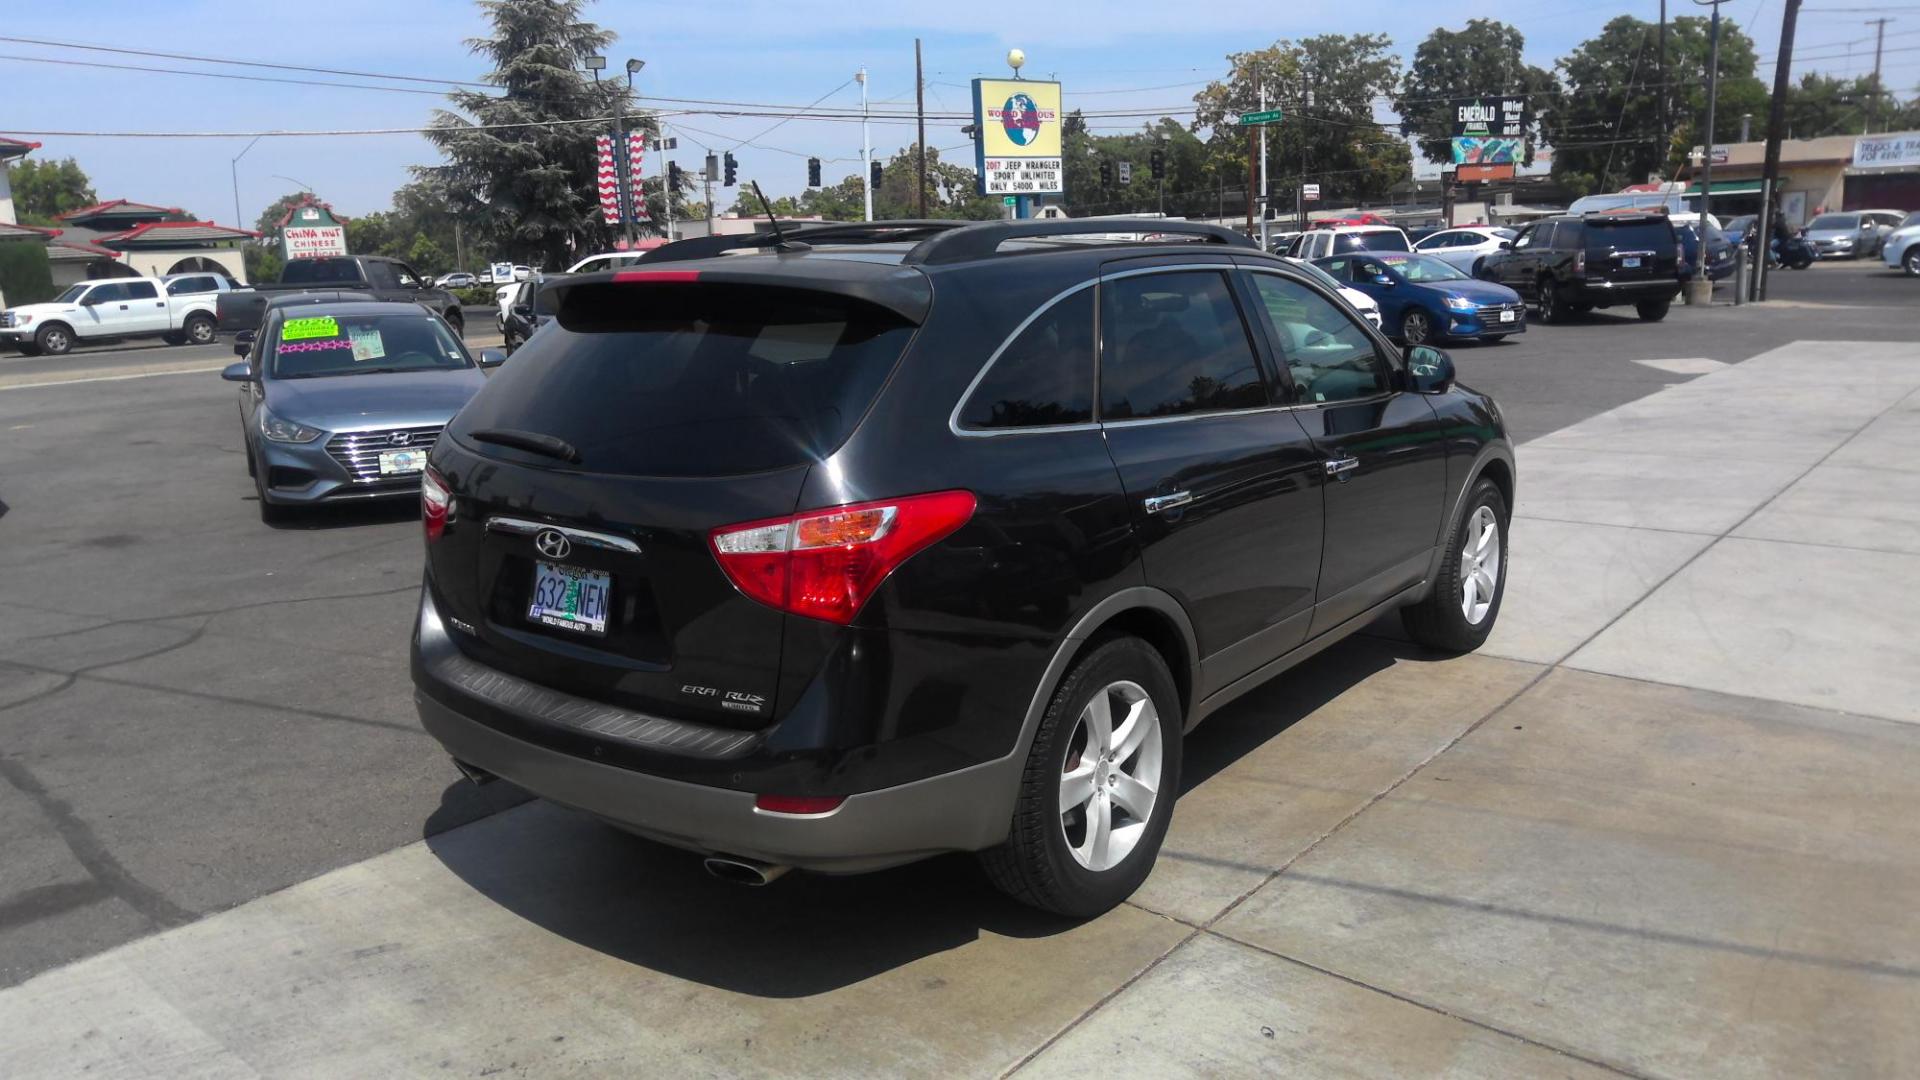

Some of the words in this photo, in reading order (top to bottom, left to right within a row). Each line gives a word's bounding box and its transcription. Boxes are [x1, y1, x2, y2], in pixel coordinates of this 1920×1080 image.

[1458, 106, 1495, 122] EMERALD
[986, 161, 1001, 170] 2017
[1005, 160, 1022, 170] JEEP
[1026, 160, 1060, 170] WRANGLER
[994, 171, 1015, 180] SPORT
[1020, 171, 1055, 180] UNLIMITED
[990, 182, 1007, 191] ONLY
[1039, 181, 1058, 190] MILES
[294, 240, 337, 248] CHINESE
[287, 317, 335, 327] 2020
[536, 576, 567, 611] 632
[575, 583, 608, 621] NEN
[542, 615, 557, 625] WORLD
[574, 621, 586, 631] AUTO
[681, 685, 717, 697] ERA
[725, 691, 766, 706] RUZ
